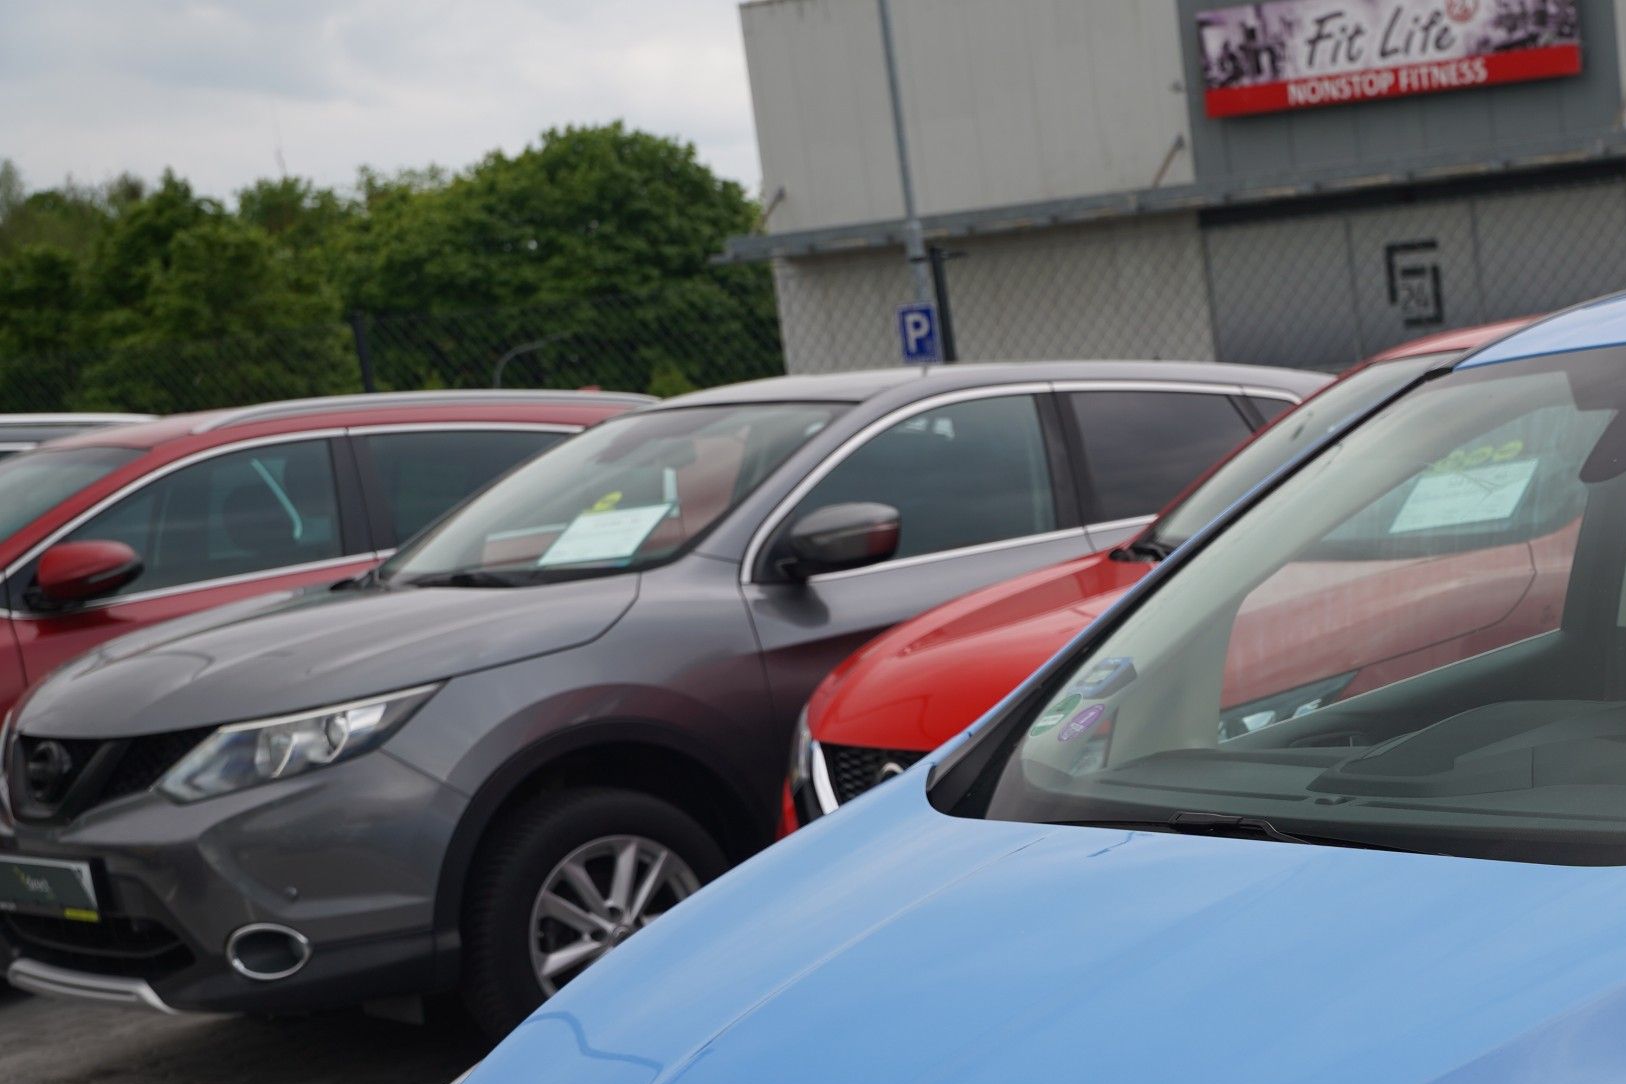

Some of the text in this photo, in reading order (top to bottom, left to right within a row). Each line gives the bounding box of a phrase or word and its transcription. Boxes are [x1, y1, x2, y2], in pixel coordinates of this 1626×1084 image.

[1305, 11, 1364, 67] Fit
[1379, 6, 1457, 58] Life
[1287, 60, 1488, 105] NONSTOP FITNESS
[905, 313, 930, 353] P
